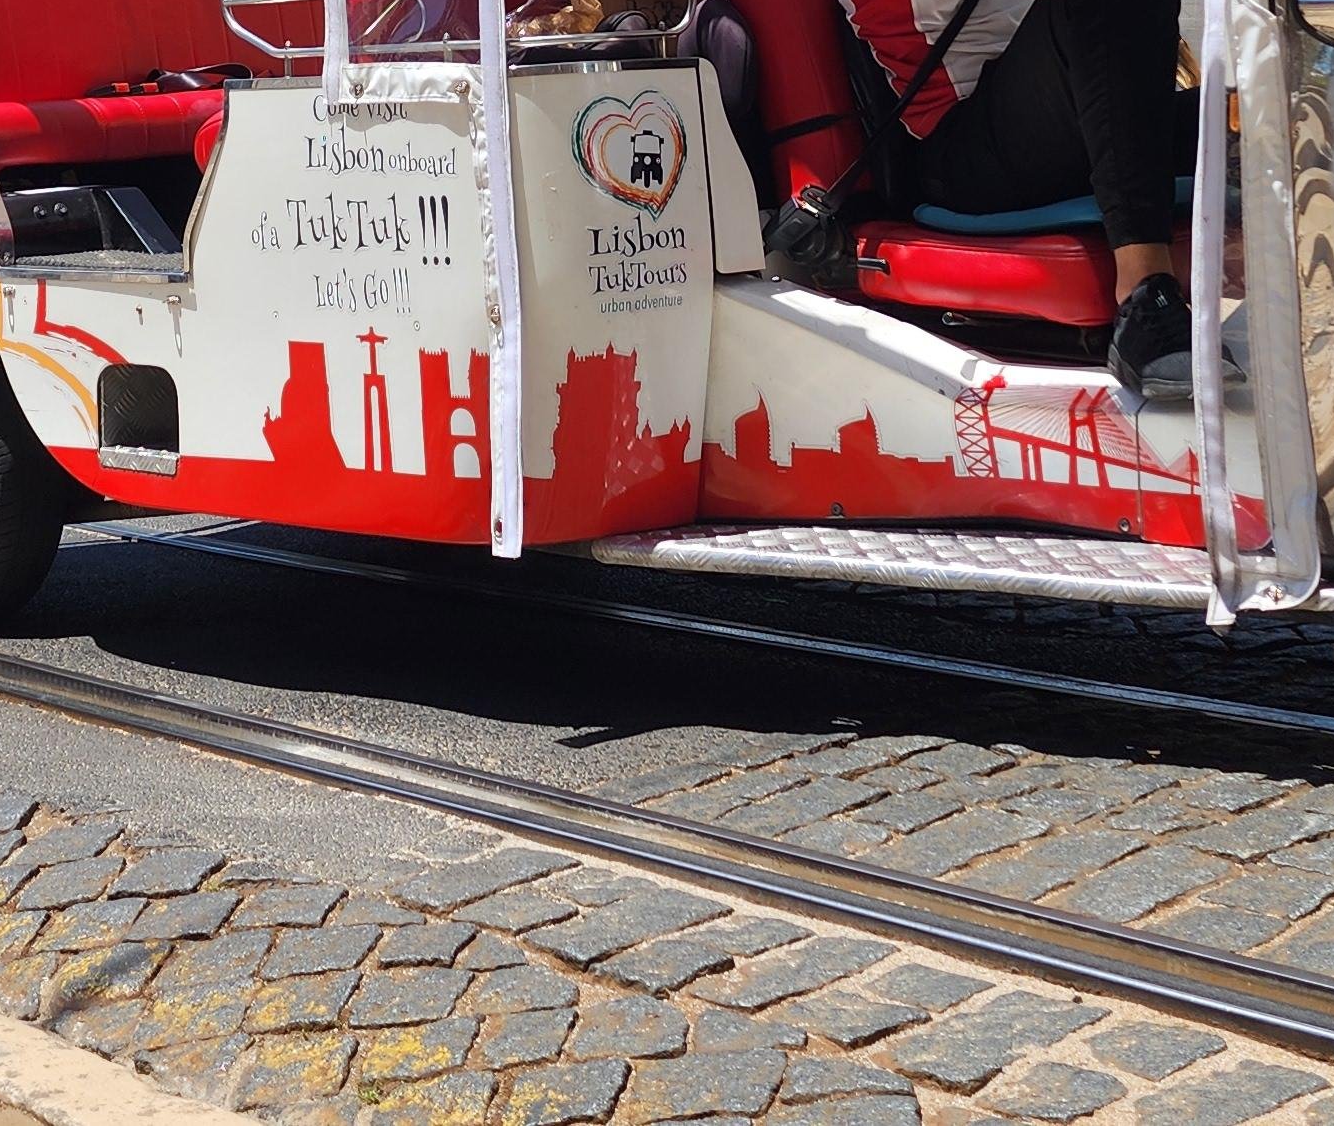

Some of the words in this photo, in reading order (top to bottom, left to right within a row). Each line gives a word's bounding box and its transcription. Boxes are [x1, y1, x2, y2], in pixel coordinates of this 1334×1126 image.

[305, 124, 386, 175] Lisbon
[388, 141, 456, 177] onboard
[587, 212, 686, 257] Lisbon
[313, 268, 357, 312] Let's
[600, 297, 632, 314] urban
[635, 294, 683, 311] adventure
